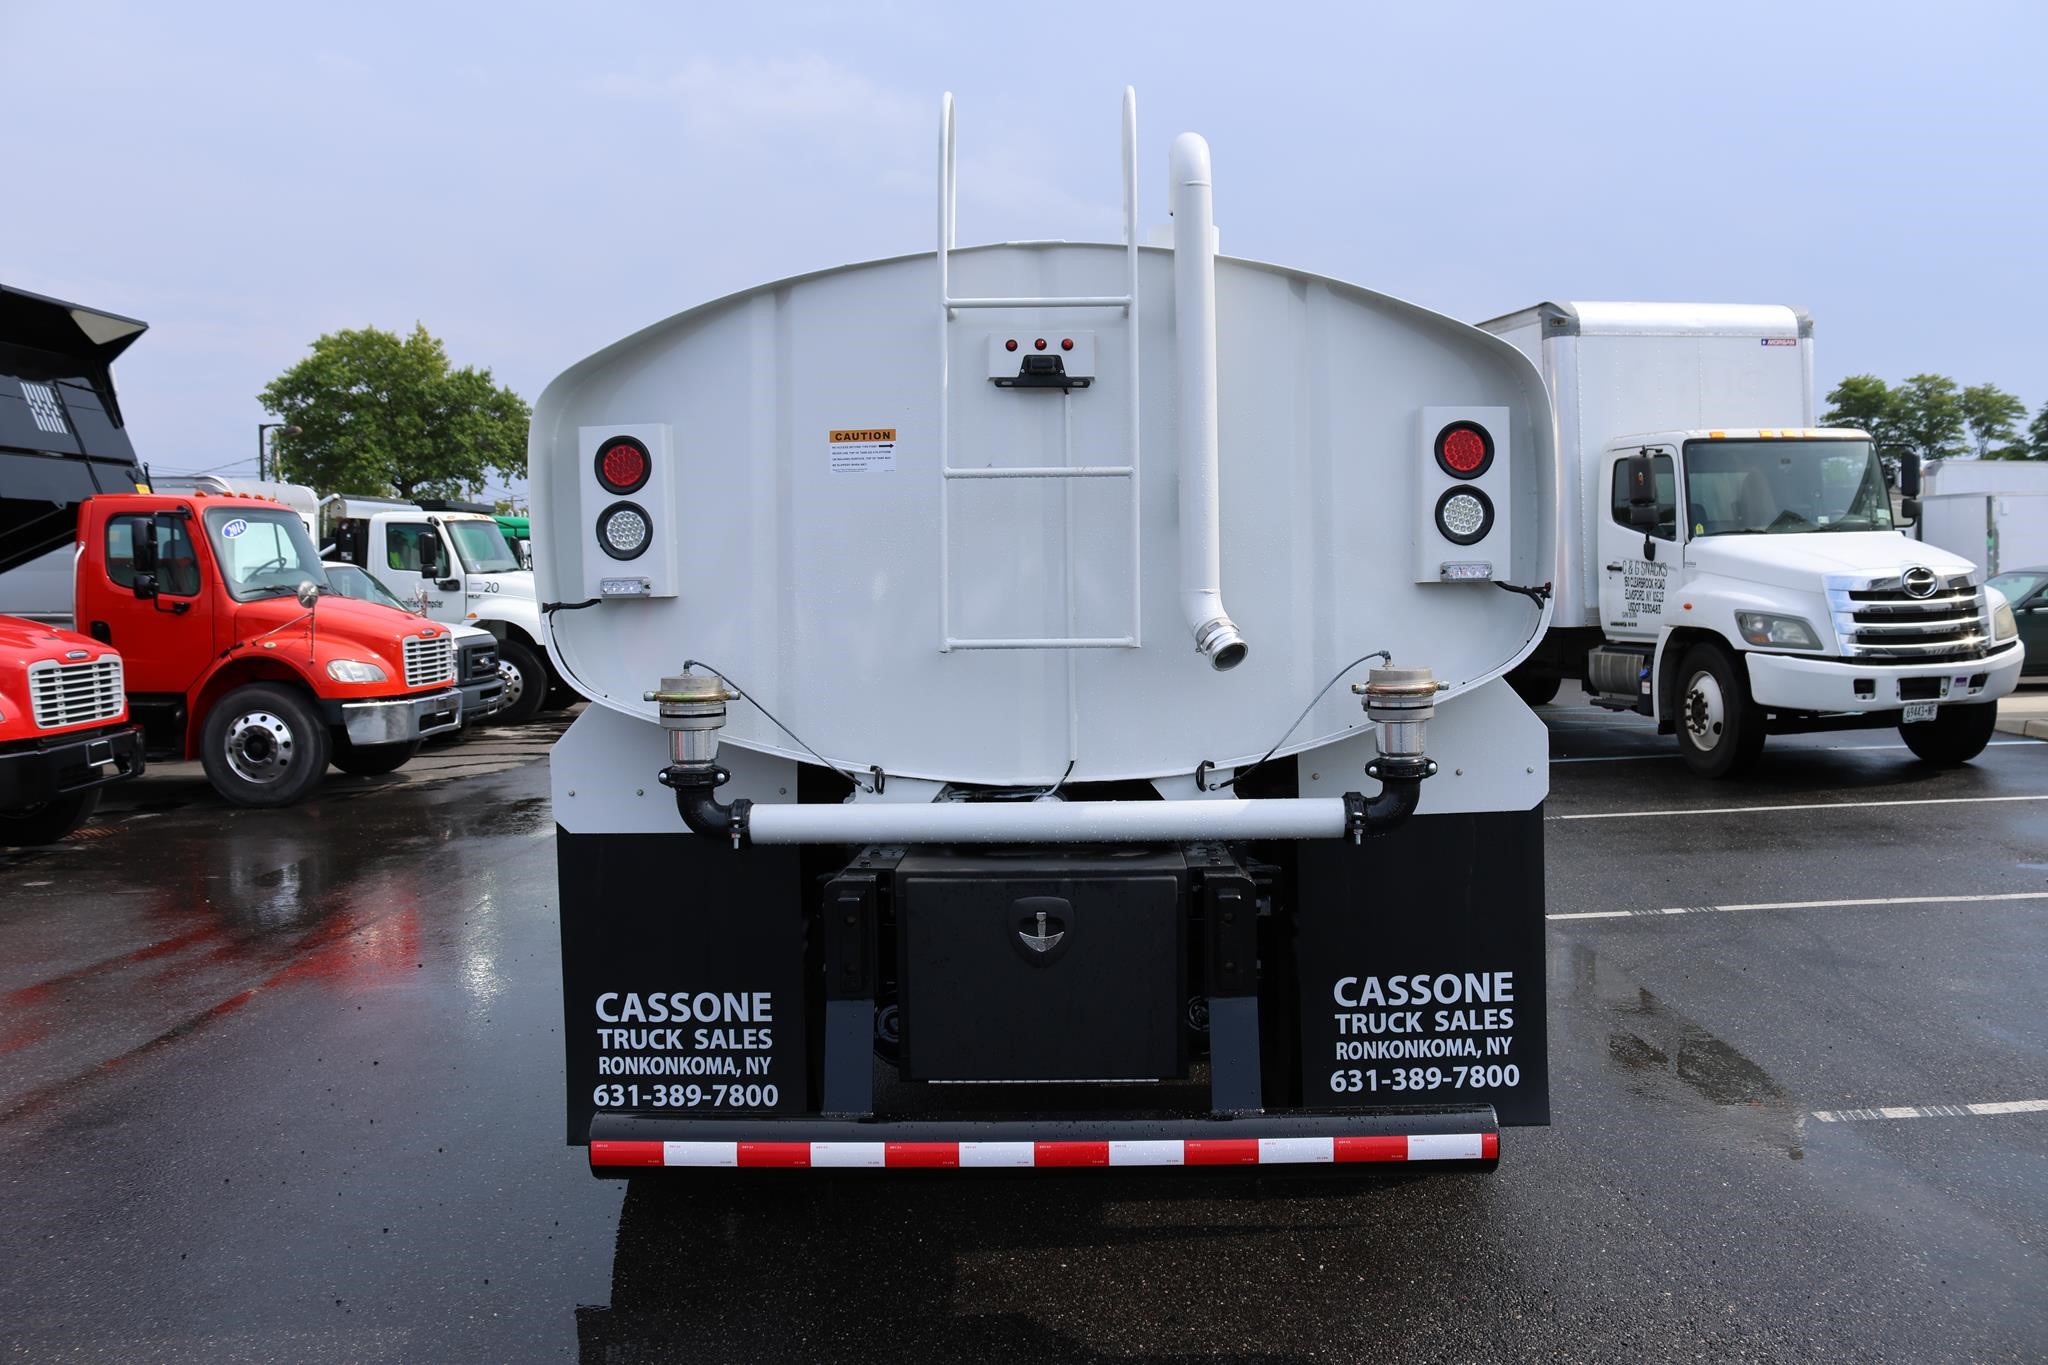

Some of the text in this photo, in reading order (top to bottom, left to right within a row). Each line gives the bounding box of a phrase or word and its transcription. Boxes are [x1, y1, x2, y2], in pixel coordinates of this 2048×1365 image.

[835, 432, 890, 441] CAUTION
[227, 521, 244, 537] 2014
[1641, 561, 1667, 577] SNACKS
[484, 581, 500, 593] 20
[1334, 972, 1513, 1007] CASSONE
[596, 993, 772, 1022] CASSONE
[1335, 1008, 1513, 1034] TRUCK SALES
[597, 1029, 772, 1049] TRUCK SALES
[1337, 1037, 1512, 1060] RONKONKOMA, NY
[599, 1057, 771, 1077] RONKONKOMA, NY
[1331, 1064, 1519, 1092] 631-389-7800
[594, 1085, 778, 1106] 631-389-7800
